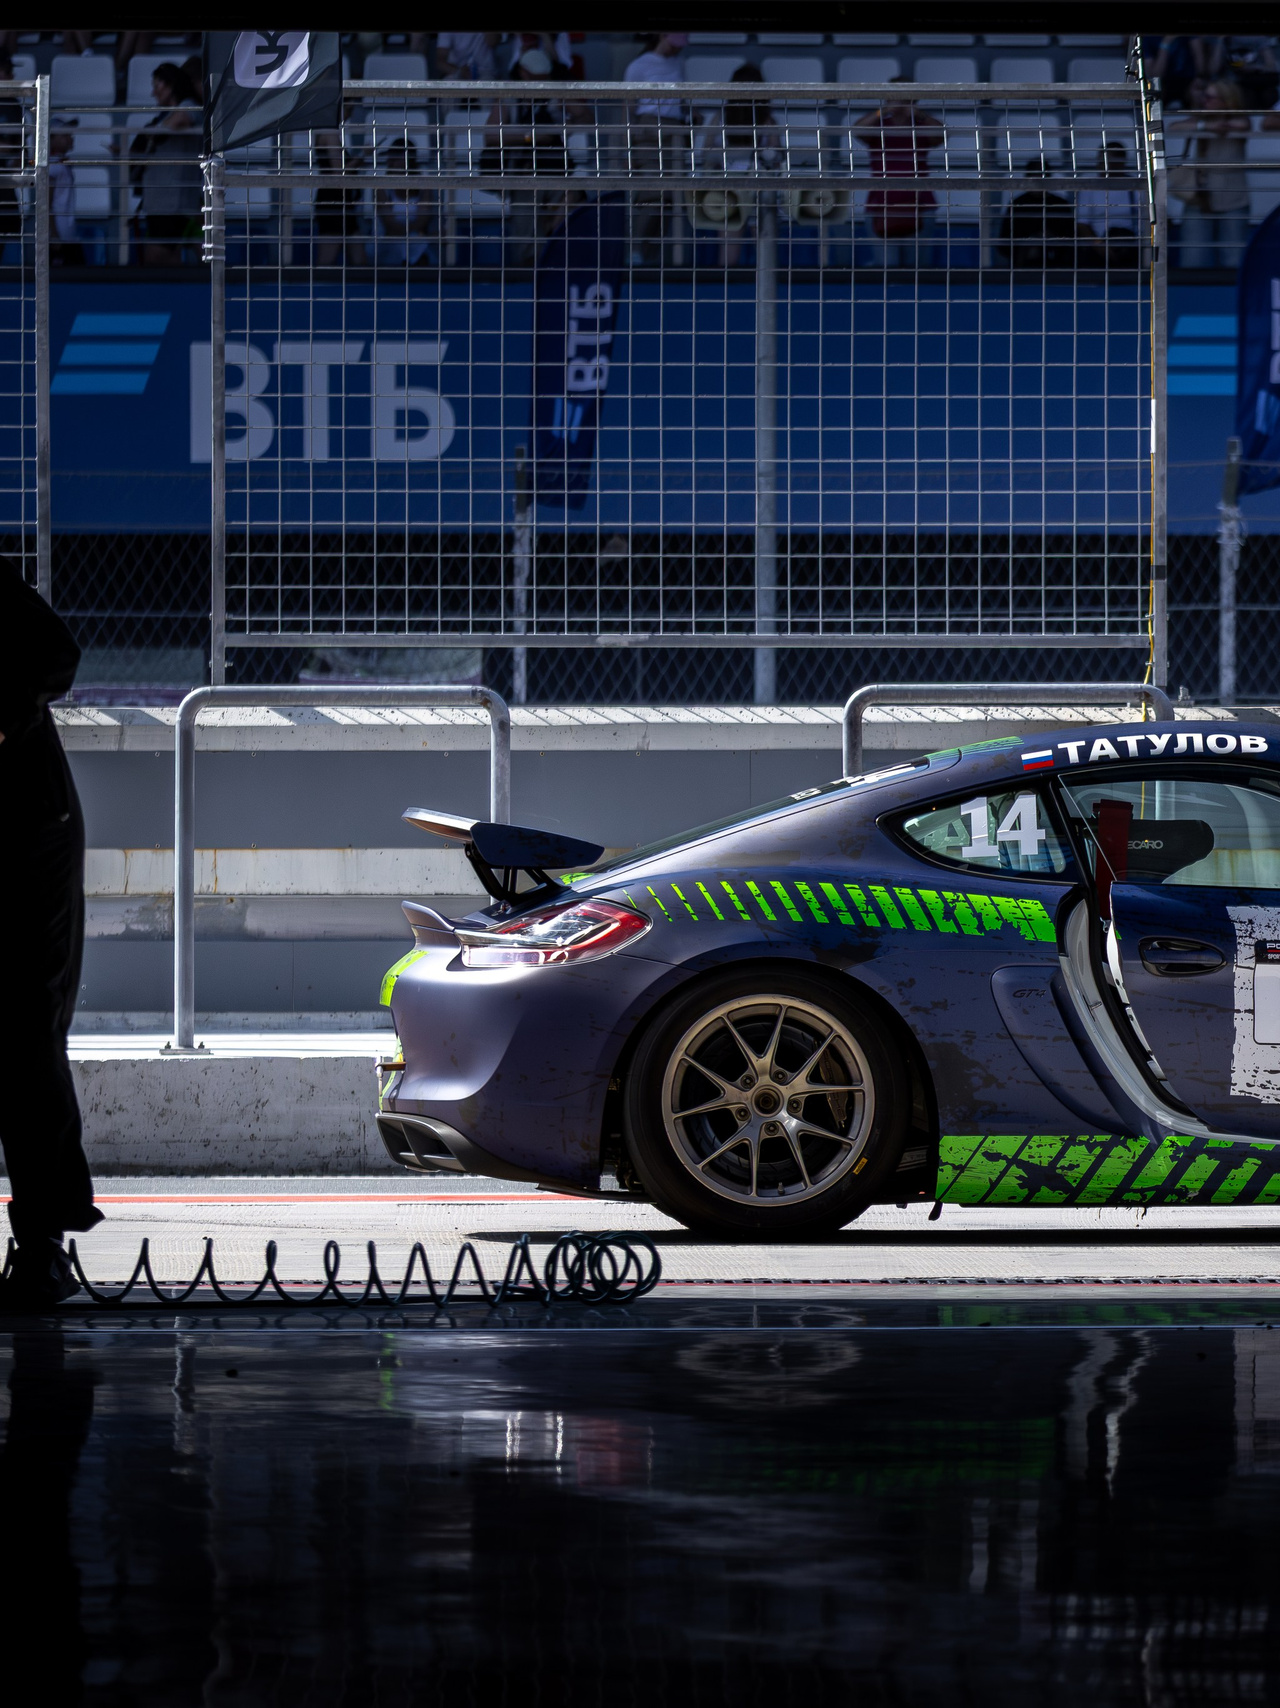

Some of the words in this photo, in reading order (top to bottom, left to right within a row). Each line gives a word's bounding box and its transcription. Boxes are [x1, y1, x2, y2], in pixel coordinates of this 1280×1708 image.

[567, 282, 613, 392] ВТБ
[190, 340, 456, 463] ВТБ
[1057, 733, 1269, 764] ТАТУЛОВ
[960, 794, 1046, 858] 14
[1127, 840, 1164, 850] ECARO
